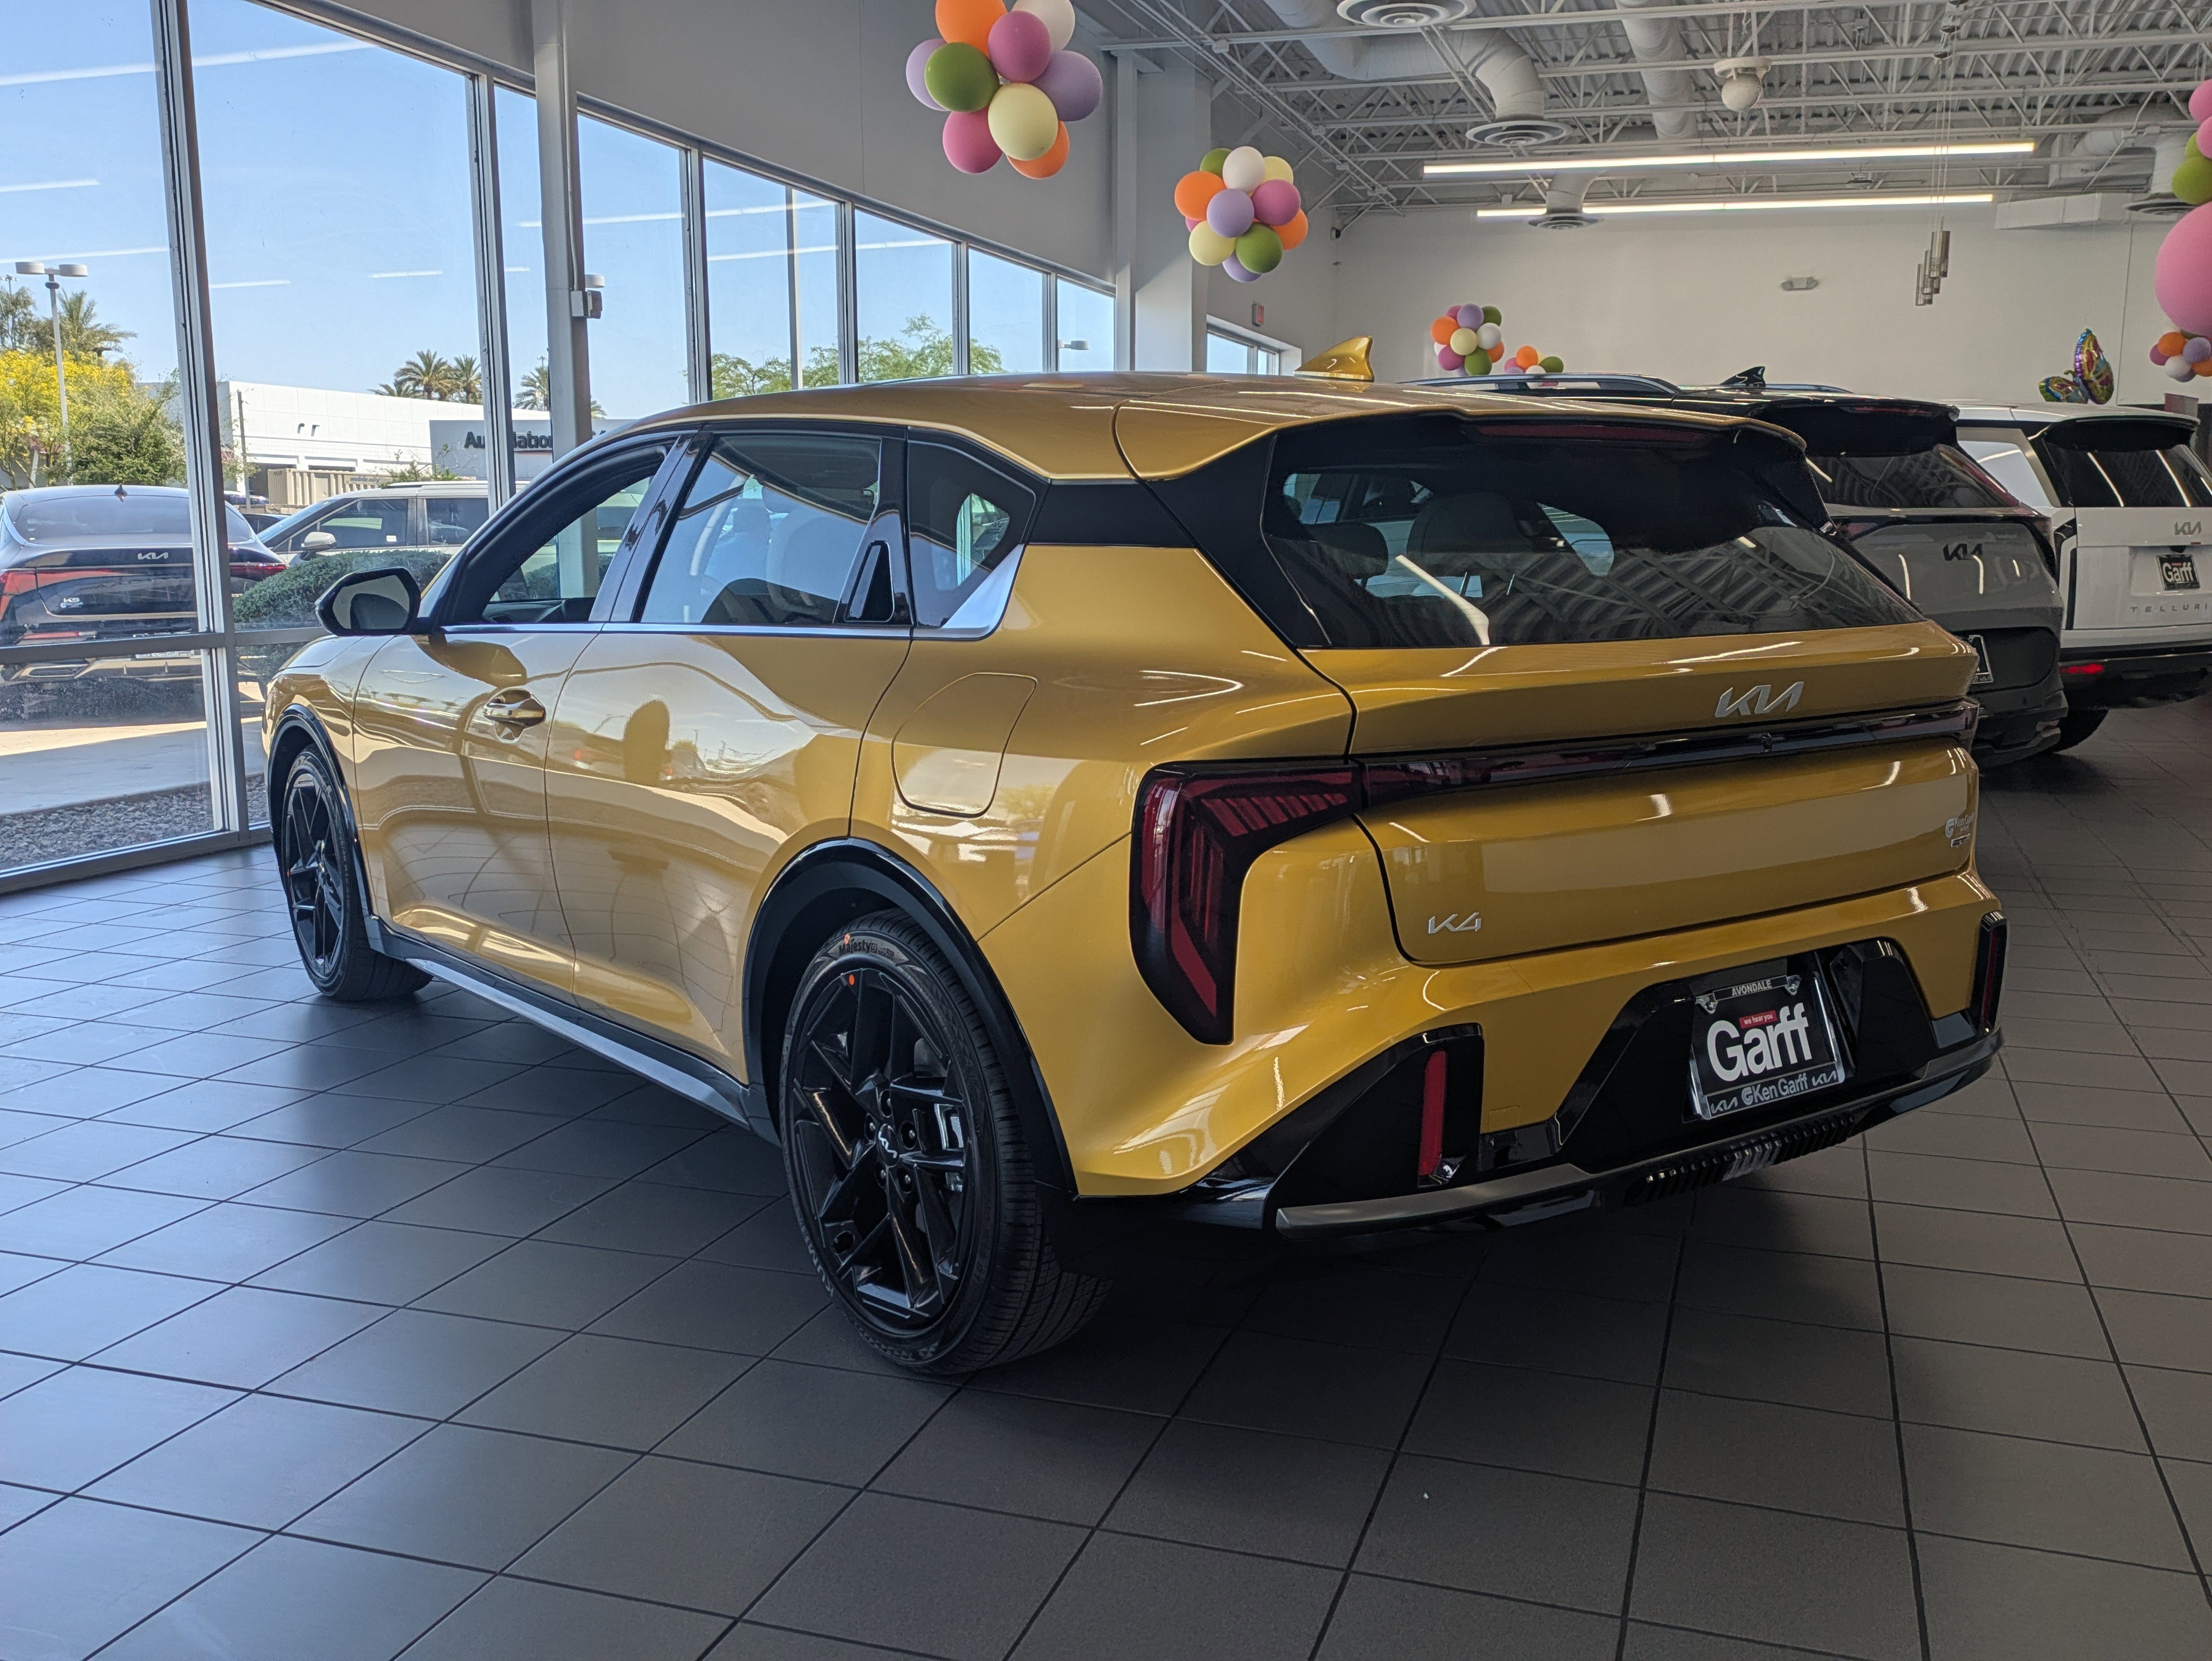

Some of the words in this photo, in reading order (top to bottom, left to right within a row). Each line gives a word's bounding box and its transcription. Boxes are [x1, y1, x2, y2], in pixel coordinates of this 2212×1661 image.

[2174, 521, 2201, 535] KIA
[1943, 543, 1982, 561] KIA
[2162, 562, 2194, 583] Garff
[1714, 681, 1804, 718] KIA
[1428, 912, 1482, 934] K4
[1732, 980, 1772, 997] AVONDALE
[1764, 1013, 1773, 1022] you
[1707, 1002, 1813, 1082] Garff
[1752, 1084, 1778, 1103] Ken
[1778, 1073, 1808, 1096] Garff
